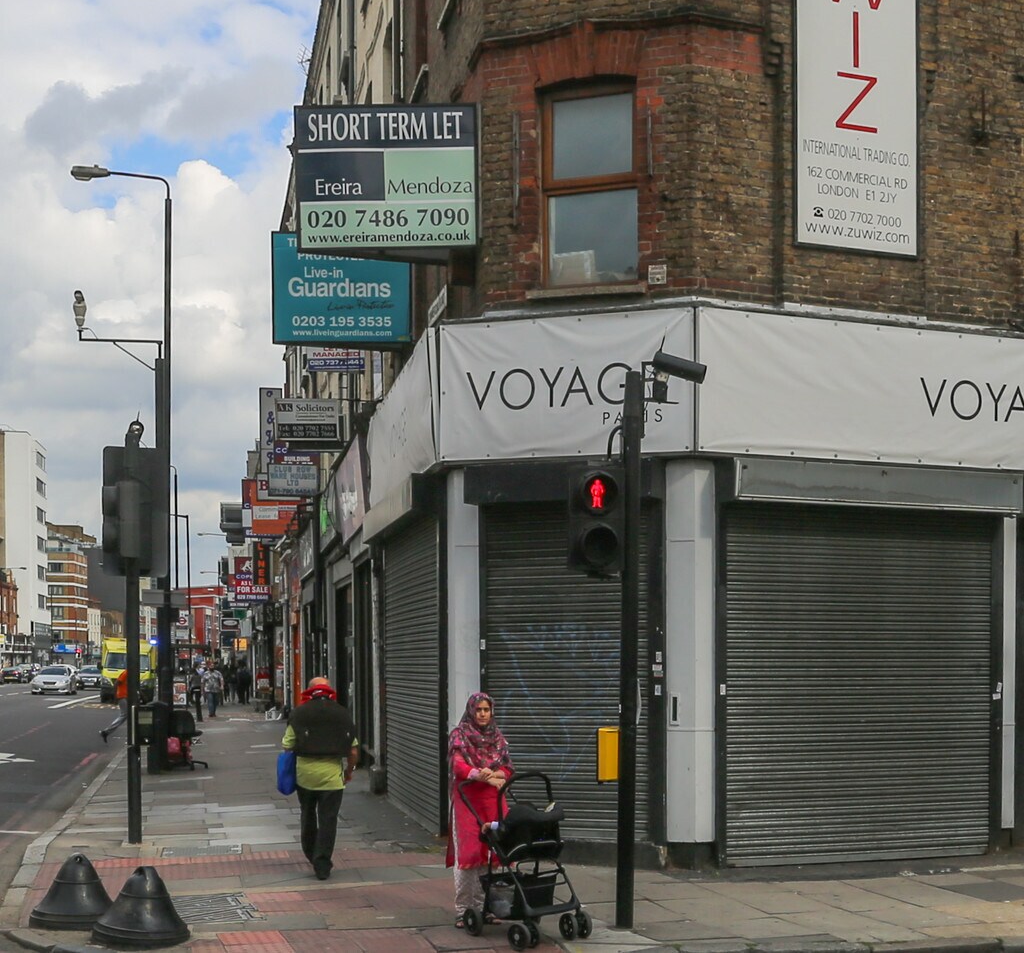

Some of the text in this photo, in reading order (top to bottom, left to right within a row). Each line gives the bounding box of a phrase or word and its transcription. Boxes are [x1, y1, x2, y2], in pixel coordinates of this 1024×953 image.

[308, 111, 463, 142] SHORT TERM LET
[803, 139, 911, 167] INTERNATIONAL TRADING CO.
[315, 176, 474, 196] Ereira Mendoza
[807, 165, 908, 189] 162 COMMERCIAL RD
[817, 183, 898, 204] LONDON E1 2JY
[307, 208, 470, 229] 020 7486 7090
[828, 208, 902, 227] 020 7702 7000
[307, 229, 471, 244] www.ereiramendoza.co.uk
[805, 222, 910, 244] www.zuwiz.com
[304, 266, 344, 278] Live-in
[288, 277, 391, 298] Guardians
[292, 316, 392, 327] 0203 195 3535
[292, 329, 393, 337] www.liveinguardians.com
[295, 403, 335, 412] Solicitors
[602, 408, 663, 425] PAIS
